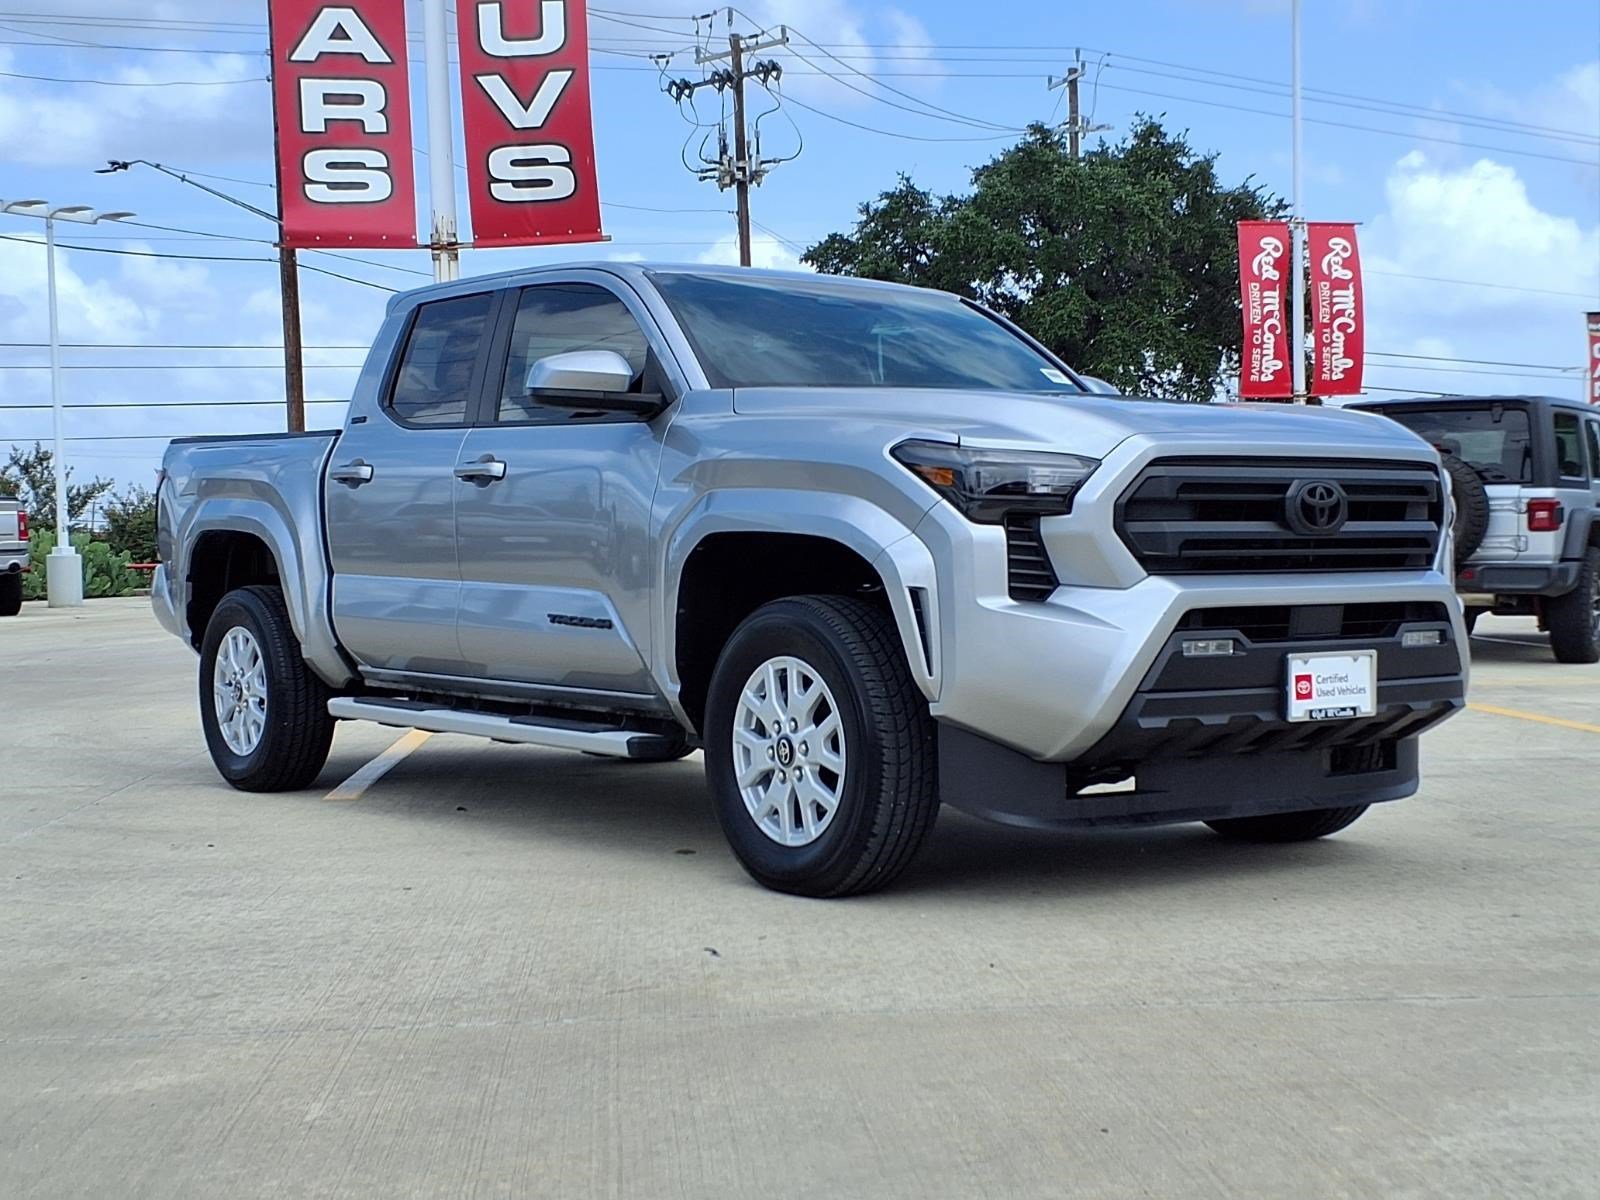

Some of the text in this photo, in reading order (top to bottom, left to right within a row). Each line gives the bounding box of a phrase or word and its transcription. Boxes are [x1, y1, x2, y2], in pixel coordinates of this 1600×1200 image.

[474, 0, 575, 203] UVS
[1250, 282, 1262, 382] DRIVEN TO SERVE
[1252, 236, 1283, 382] Red McCombs
[1321, 237, 1355, 381] Red McCombs
[1321, 281, 1331, 381] DRIVEN TO SERVE
[1316, 674, 1348, 684] Certified
[1316, 686, 1367, 697] Used Vehicles
